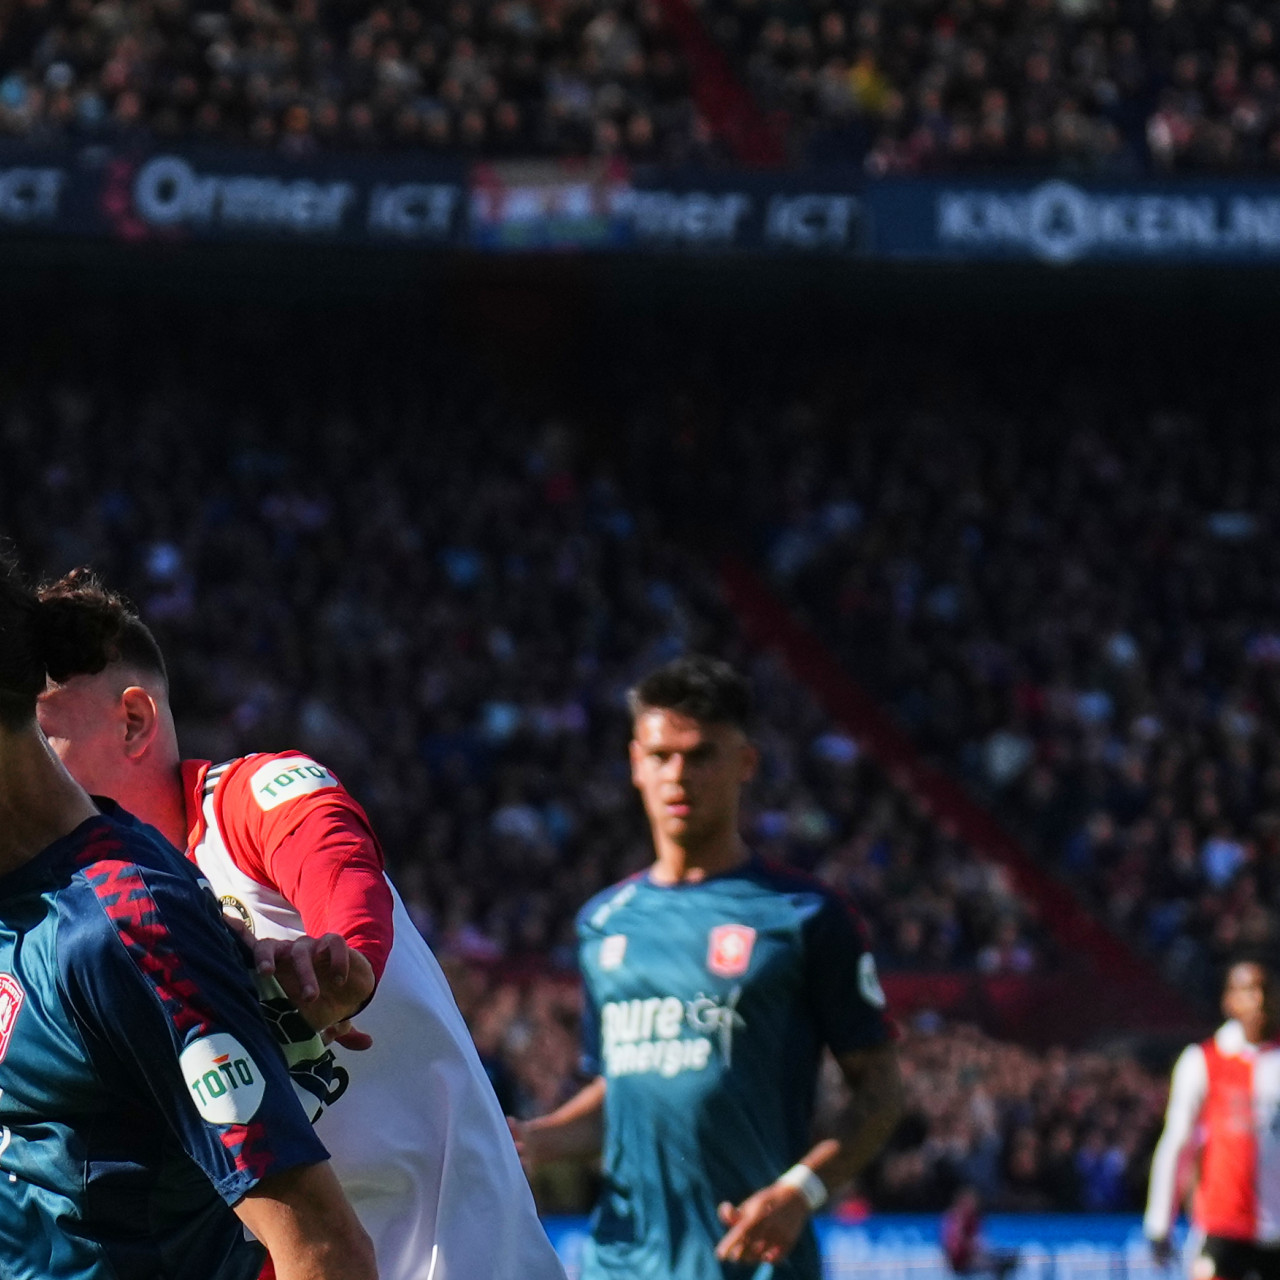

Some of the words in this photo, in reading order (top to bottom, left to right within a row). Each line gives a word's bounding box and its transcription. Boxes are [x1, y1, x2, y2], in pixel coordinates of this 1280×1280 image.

[260, 765, 325, 798] TOTO
[602, 996, 684, 1043] pure
[603, 1036, 713, 1078] energie
[192, 1058, 254, 1107] TOTO
